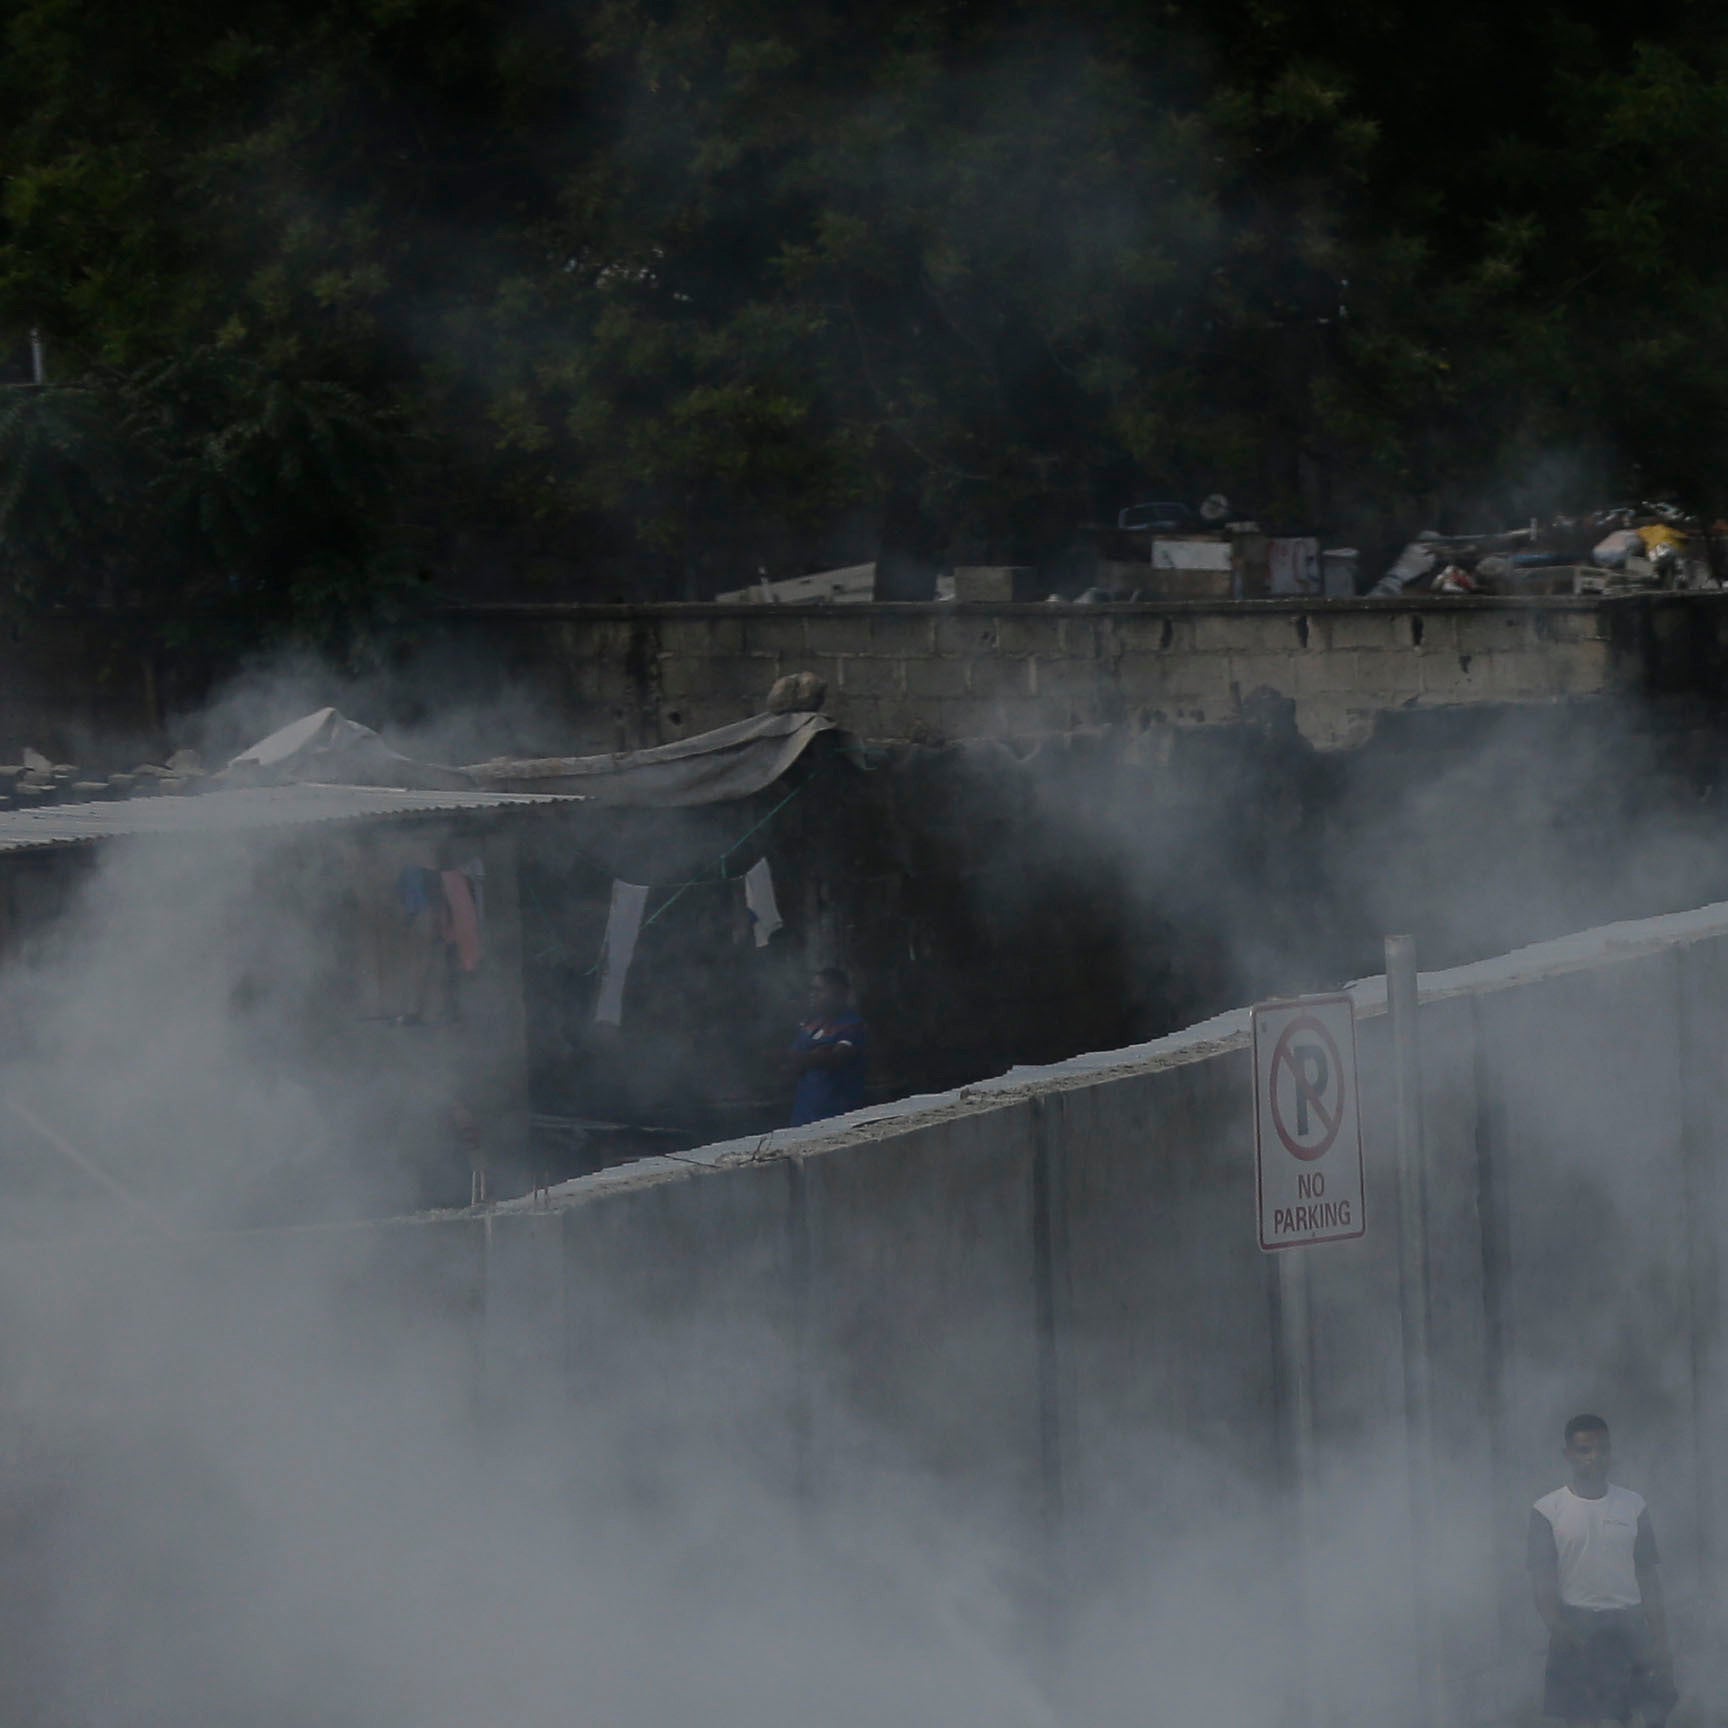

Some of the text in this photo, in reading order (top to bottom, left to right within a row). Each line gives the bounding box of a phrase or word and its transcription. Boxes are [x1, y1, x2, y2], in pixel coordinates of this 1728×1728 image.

[1294, 1045, 1329, 1136] P
[1298, 1172, 1325, 1199] NO
[1274, 1201, 1351, 1235] PARKING
